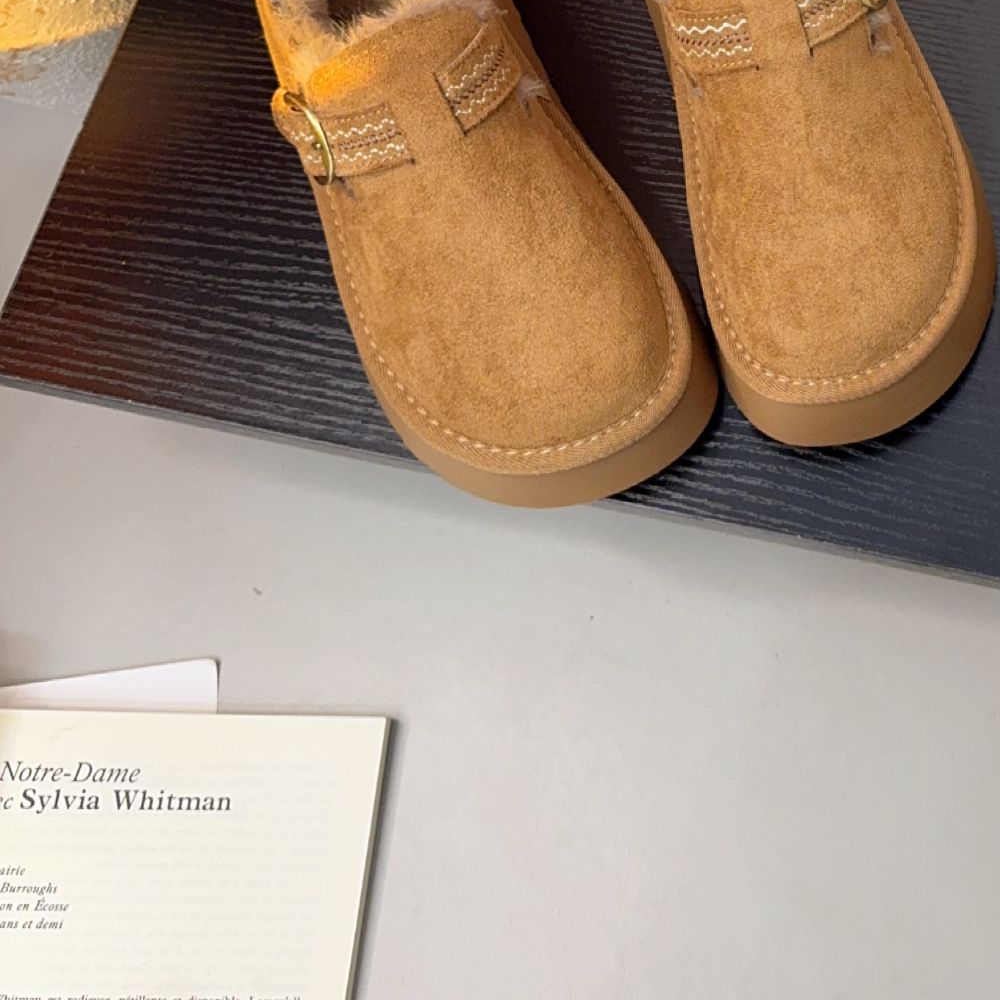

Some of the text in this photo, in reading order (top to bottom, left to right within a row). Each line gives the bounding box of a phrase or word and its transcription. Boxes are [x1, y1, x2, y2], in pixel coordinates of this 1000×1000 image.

[0, 760, 141, 783] Notre-Dame
[20, 788, 100, 815] Sylvia
[113, 789, 232, 811] Whitman
[0, 882, 58, 896] Burroughs
[16, 903, 30, 912] en
[22, 920, 33, 929] et
[35, 917, 64, 930] demi
